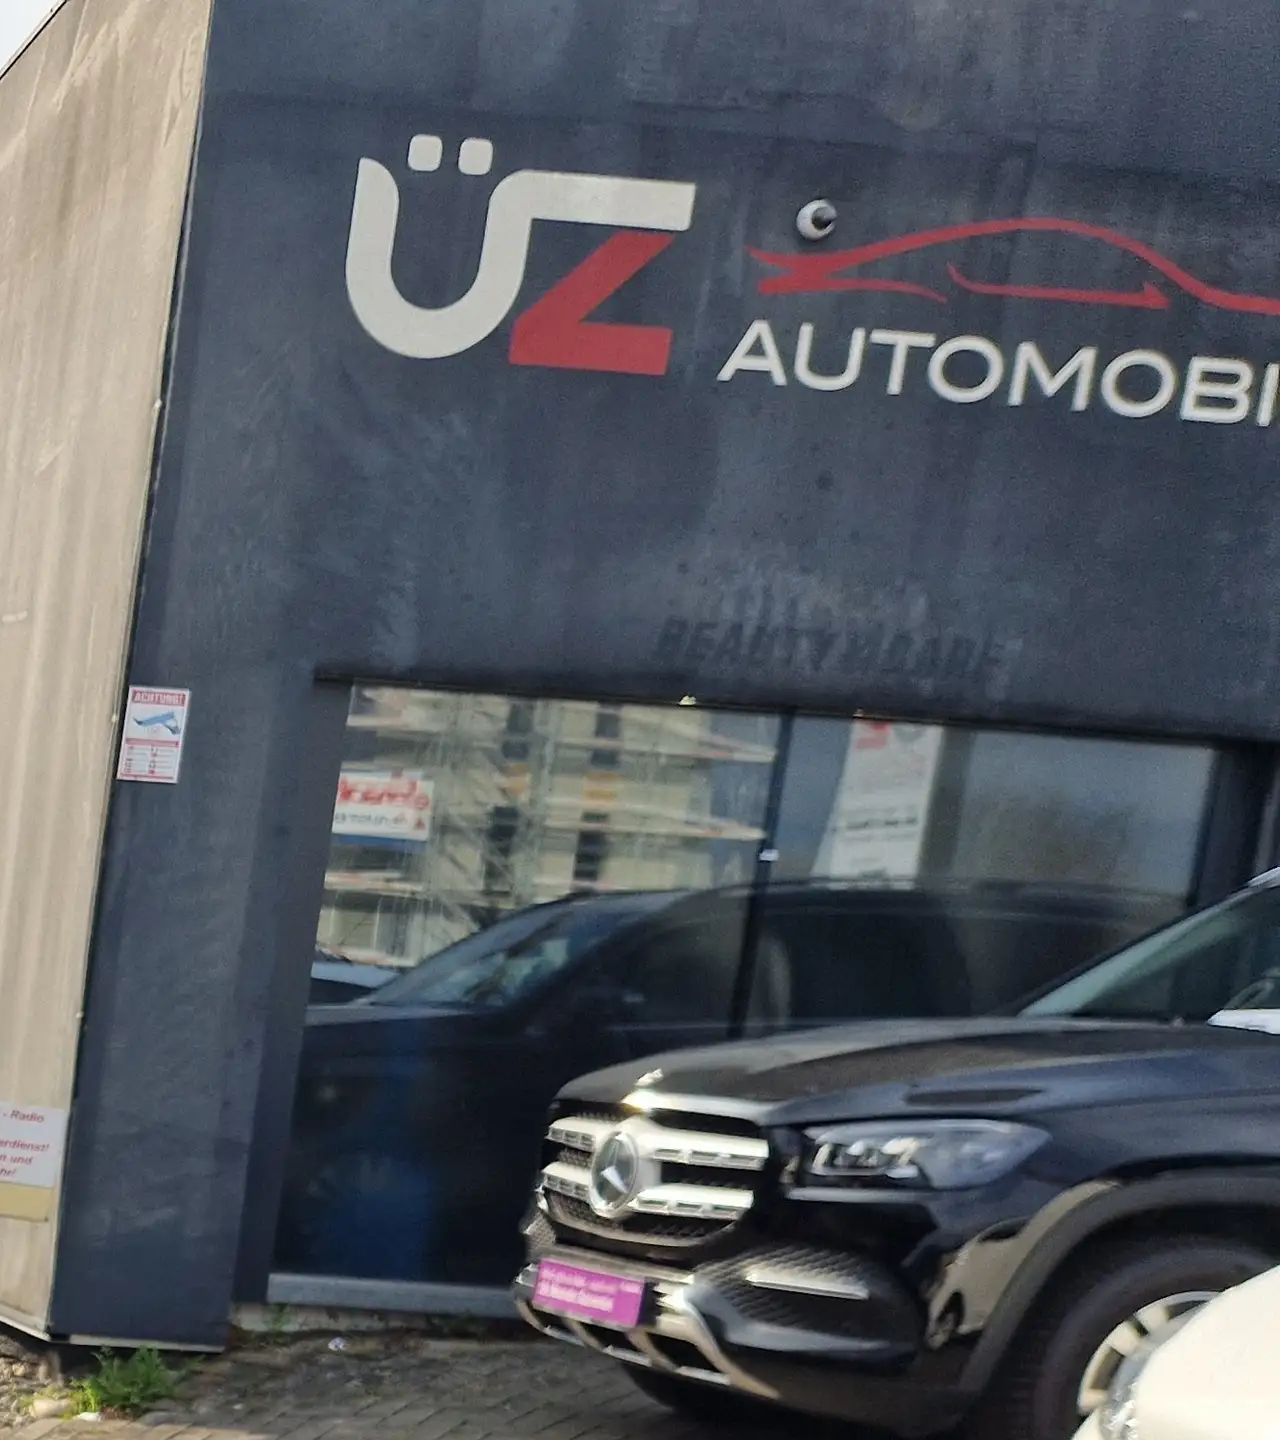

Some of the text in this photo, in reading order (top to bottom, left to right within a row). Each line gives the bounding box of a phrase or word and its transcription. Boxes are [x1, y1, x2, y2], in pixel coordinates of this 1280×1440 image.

[345, 134, 1280, 427] ÜZ AUTOMOBI
[10, 1109, 45, 1123] Radio
[10, 1155, 34, 1166] und
